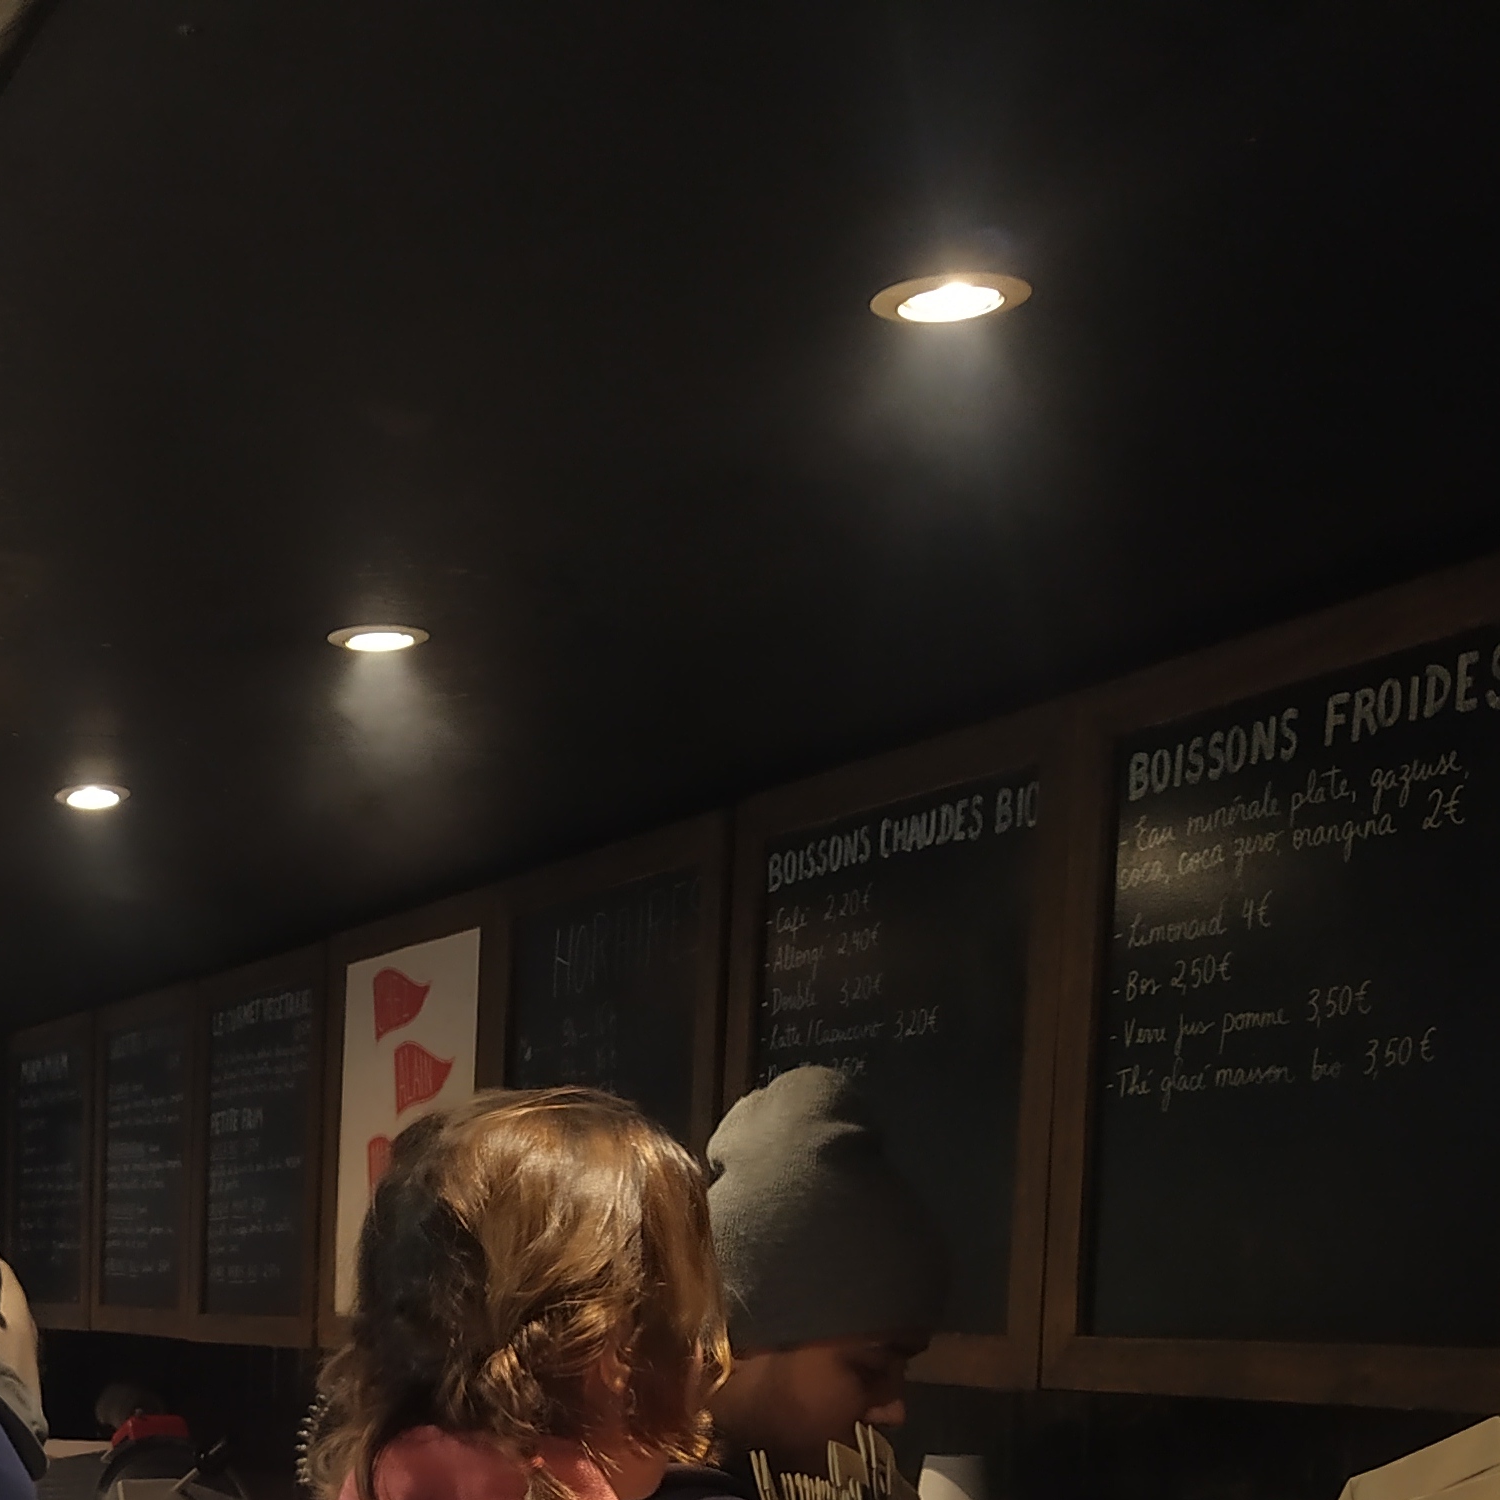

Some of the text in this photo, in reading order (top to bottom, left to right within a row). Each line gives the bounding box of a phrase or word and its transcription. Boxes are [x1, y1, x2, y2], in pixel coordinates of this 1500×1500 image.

[1128, 707, 1300, 803] BOISSONS
[767, 780, 1041, 893] BOISSONS CHAUDES BIO
